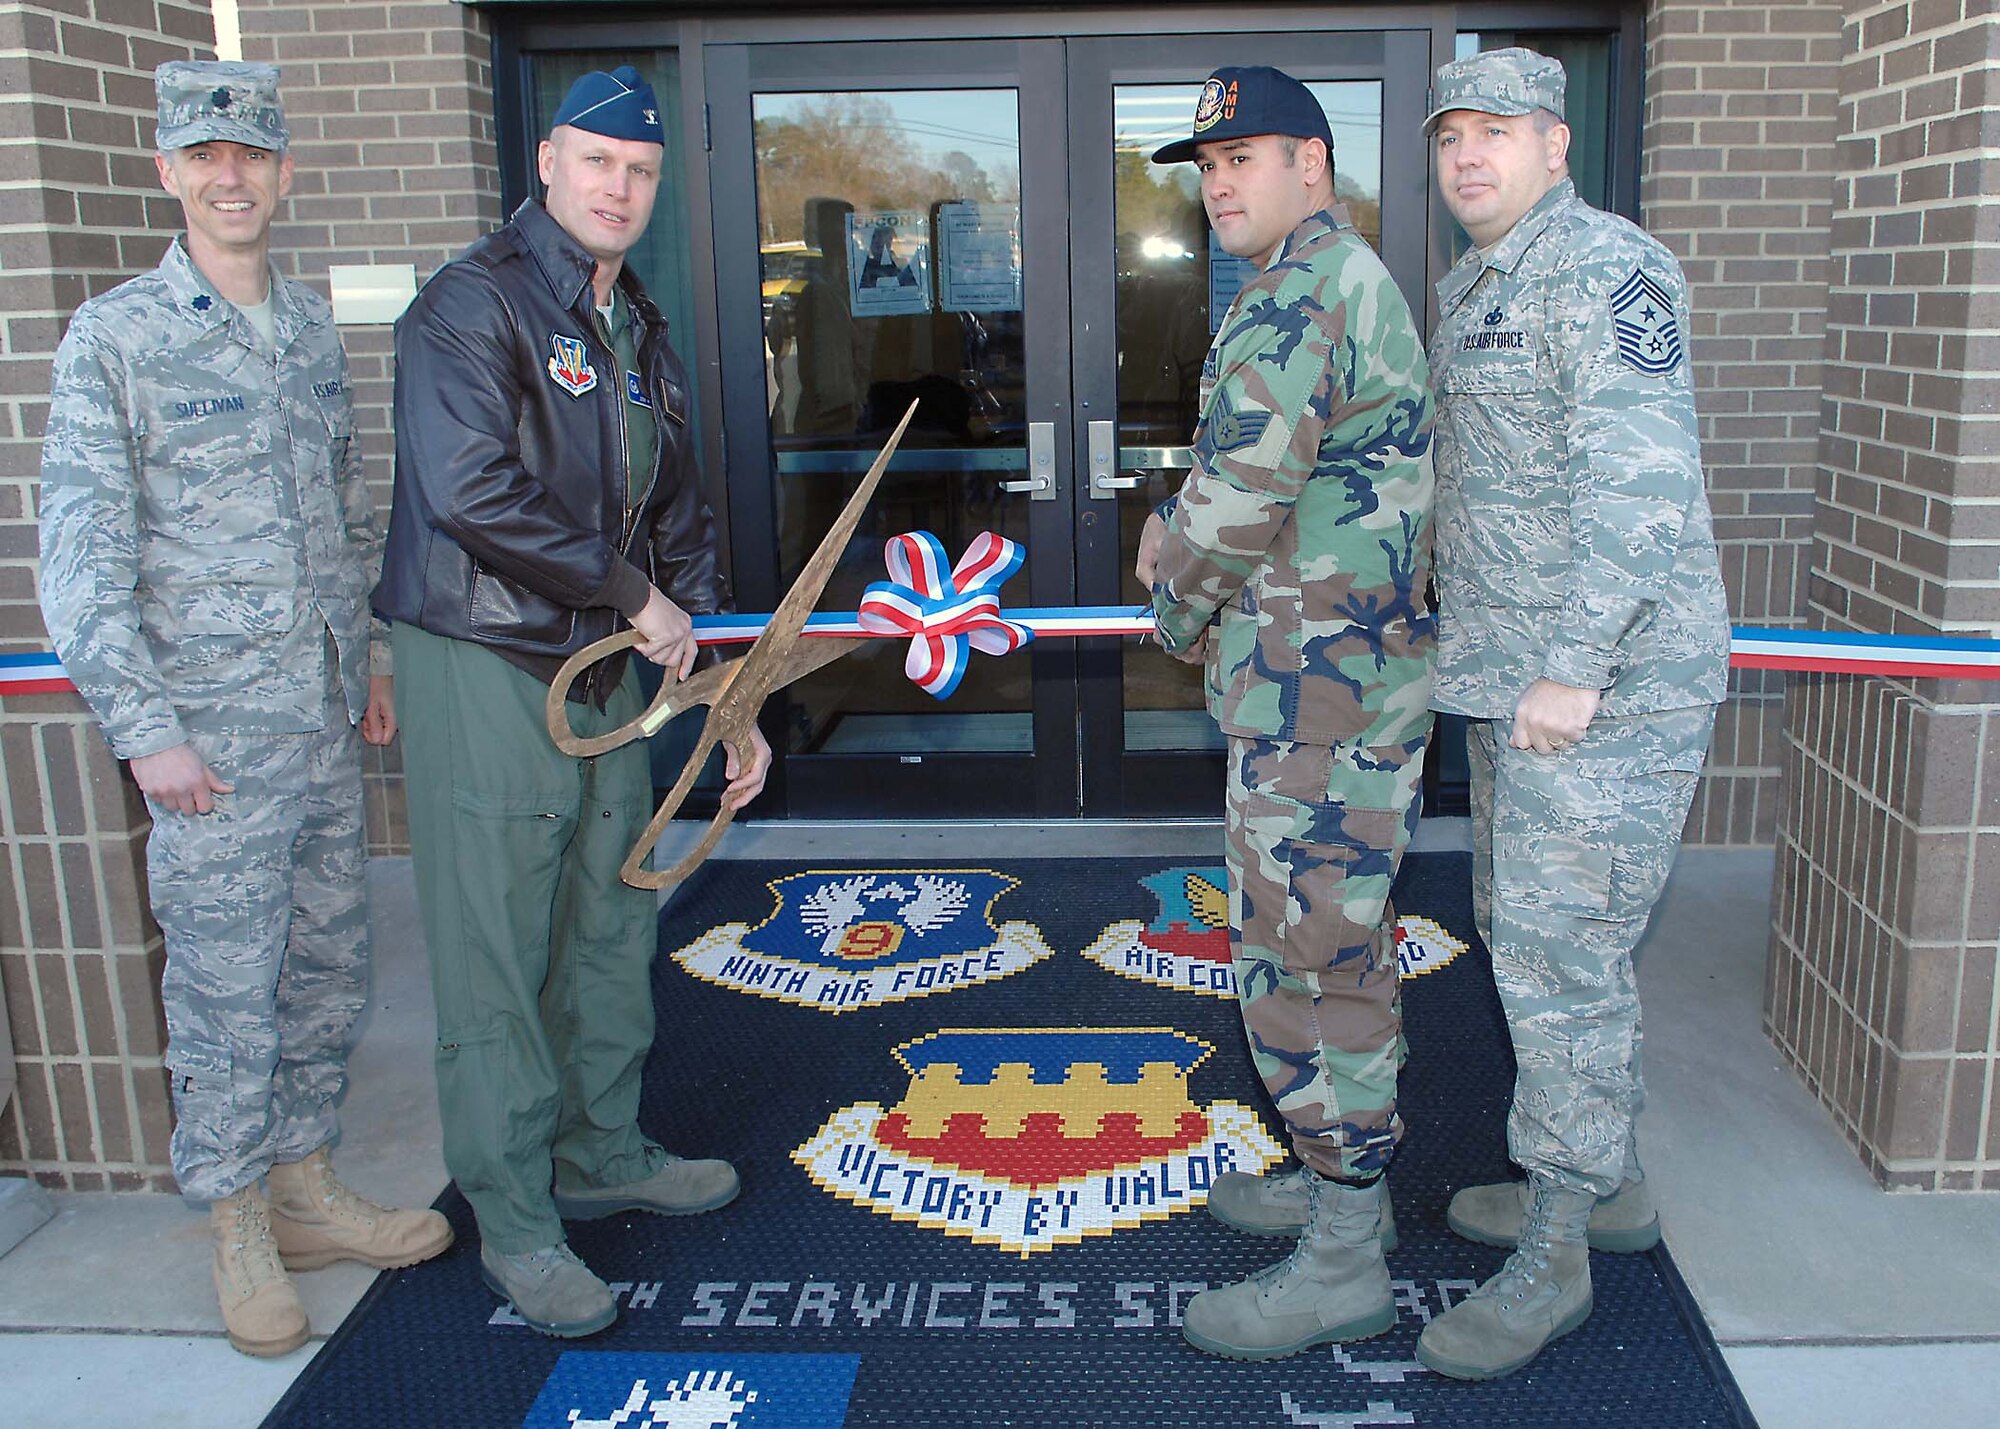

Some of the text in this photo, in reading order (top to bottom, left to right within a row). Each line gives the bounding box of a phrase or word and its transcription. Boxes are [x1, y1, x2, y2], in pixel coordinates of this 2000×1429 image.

[1225, 80, 1238, 120] AMU
[175, 396, 245, 418] SULLIVAN
[719, 950, 1005, 1006] NINTH AIR FORCE
[1125, 945, 1174, 978] AIR
[837, 1142, 1238, 1236] VICTORY BY VALOR
[681, 1281, 1080, 1328] SERVICES
